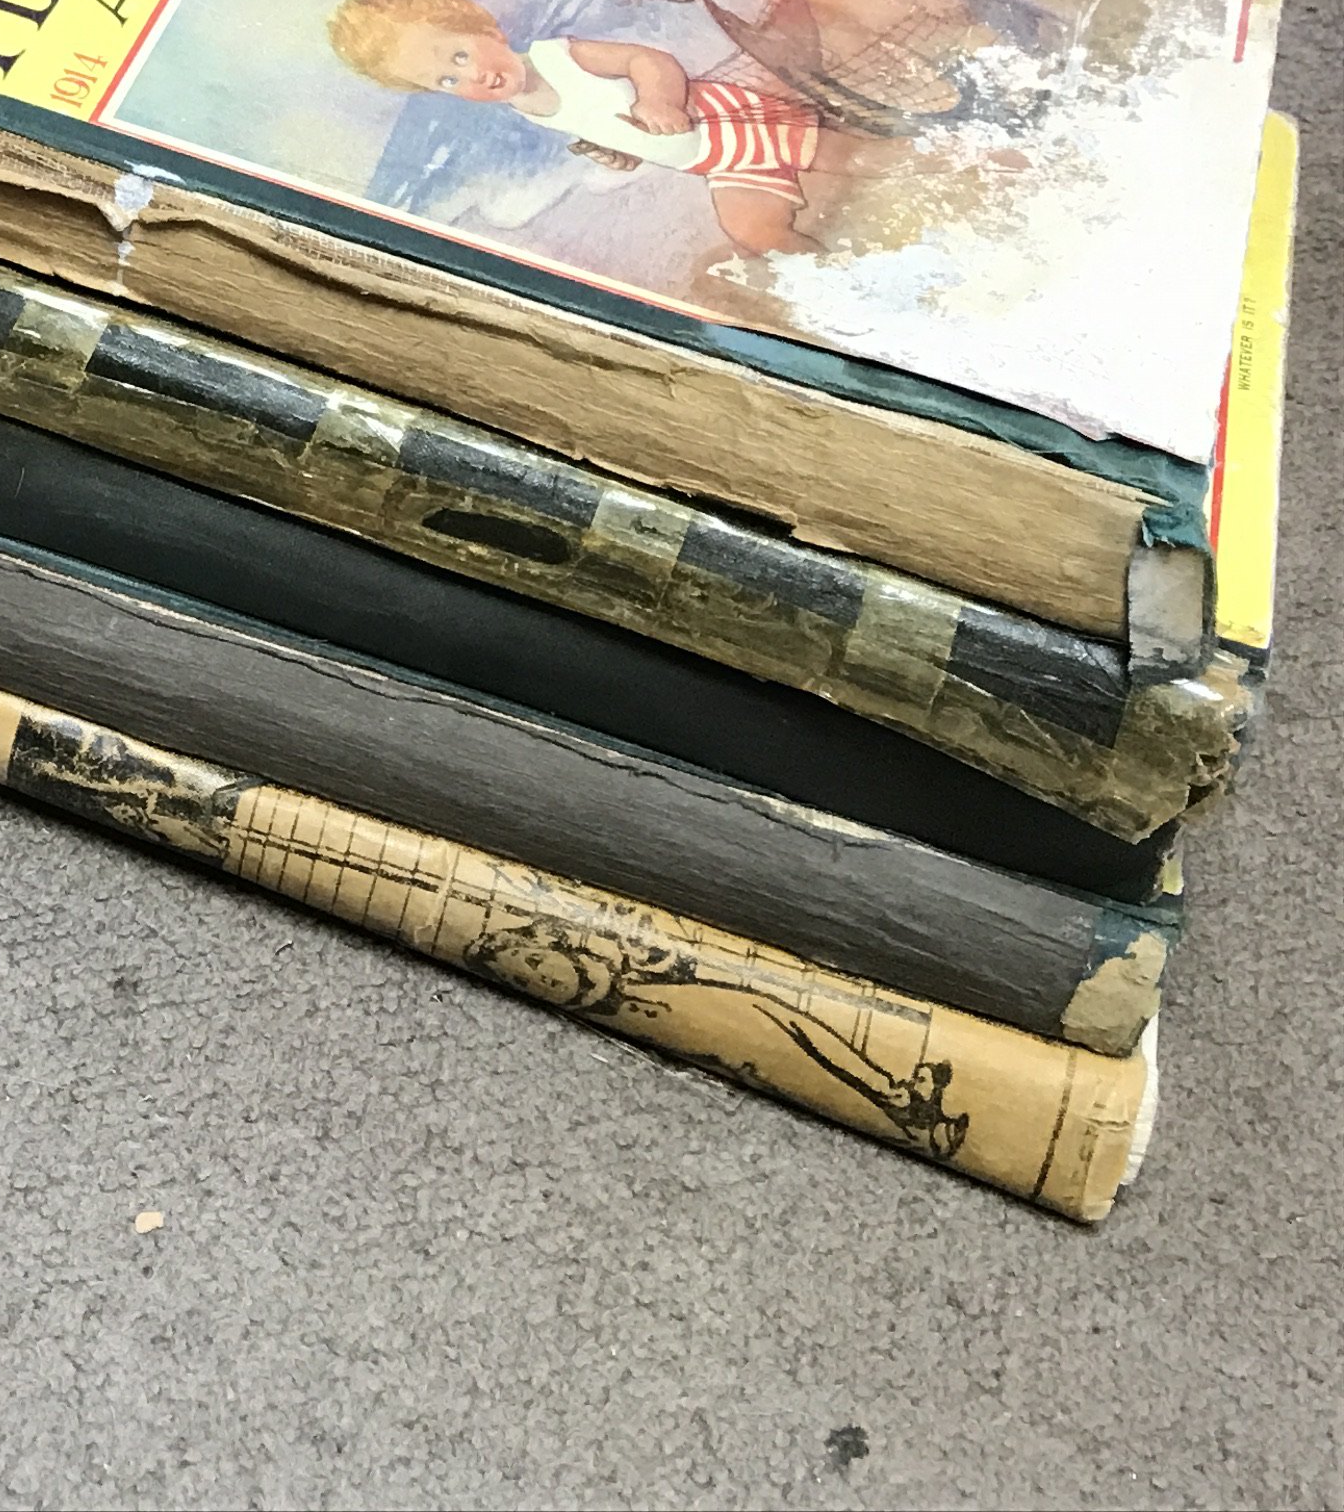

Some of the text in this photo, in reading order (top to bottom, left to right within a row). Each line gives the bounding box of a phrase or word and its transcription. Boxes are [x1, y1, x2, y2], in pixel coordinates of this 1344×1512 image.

[51, 52, 108, 107] 1914
[1242, 320, 1254, 330] IS
[1238, 335, 1252, 390] WHATEVER
